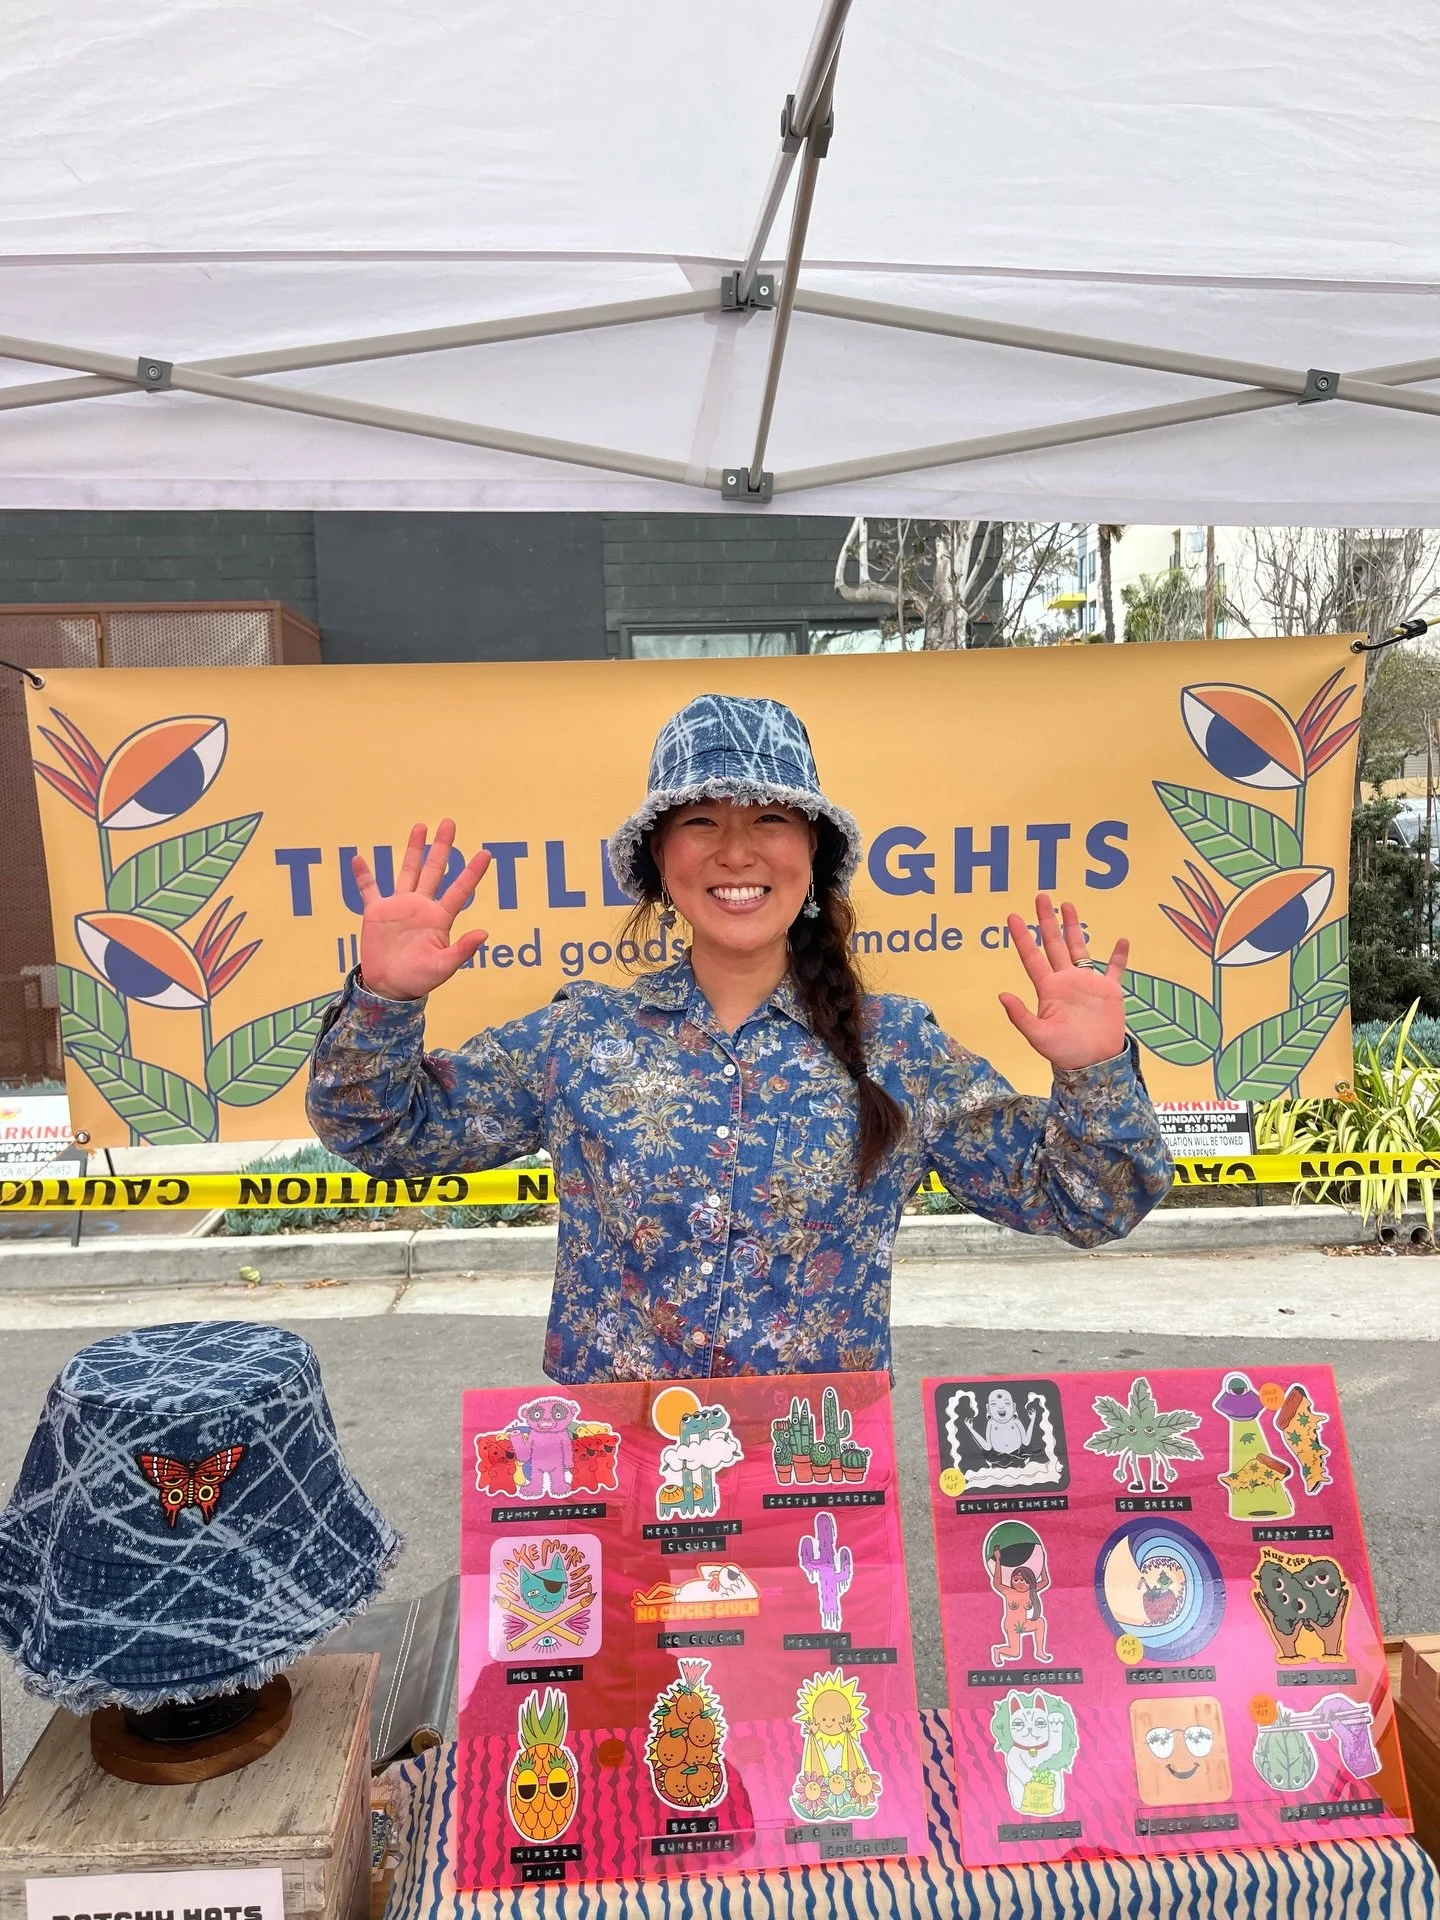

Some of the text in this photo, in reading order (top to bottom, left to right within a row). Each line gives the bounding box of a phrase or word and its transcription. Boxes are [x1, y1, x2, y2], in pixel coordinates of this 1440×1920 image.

[868, 820, 1130, 896] GHTS
[560, 928, 687, 976] goods
[1158, 1114, 1236, 1124] SUNDAY FROM
[1184, 1124, 1209, 1132] 5:30
[1211, 1123, 1228, 1132] PM
[1163, 1135, 1244, 1147] OLATION WILL BE TOWED
[238, 1174, 469, 1206] CAUTION
[769, 1495, 876, 1506] CACTUS GARDEN
[959, 1499, 1065, 1512] ENLIGHTENMENT
[1119, 1499, 1183, 1510] GO GREEN
[498, 1507, 597, 1520] GUMMY ATTACK
[646, 1523, 738, 1536] HEAD IN THE
[668, 1541, 717, 1551] CLOUDS
[541, 1538, 586, 1571] MORE
[1262, 1549, 1306, 1567] Nug Life
[637, 1600, 759, 1620] NO CLUCKS GIVEN
[665, 1632, 741, 1646] NO CLUCKS
[838, 1652, 888, 1663] CACTUS
[549, 1668, 574, 1678] ART
[971, 1671, 1081, 1684] GANJA GODDESS
[671, 1821, 698, 1832] BAG
[659, 1839, 731, 1853] SUNSHINE
[516, 1848, 578, 1859] HIPSTER
[526, 1867, 561, 1877] PINA
